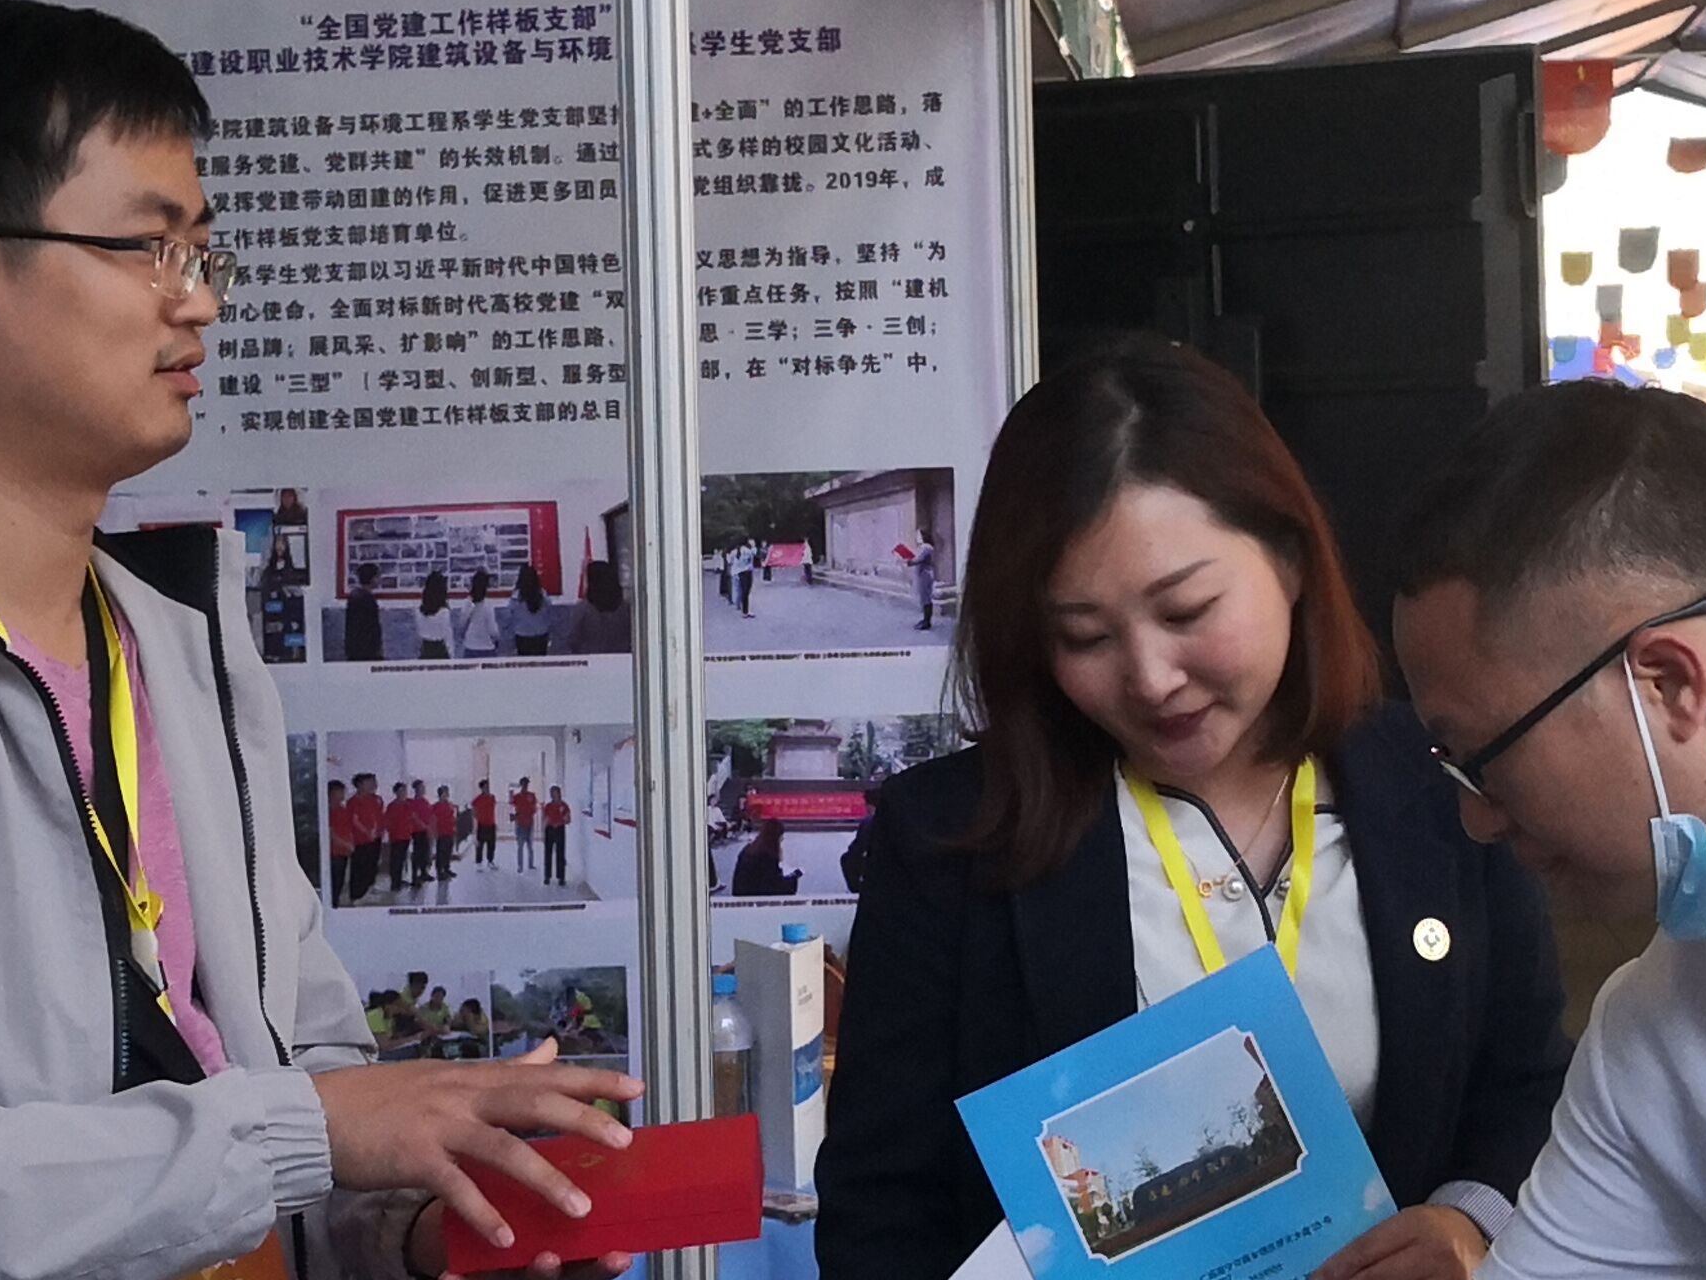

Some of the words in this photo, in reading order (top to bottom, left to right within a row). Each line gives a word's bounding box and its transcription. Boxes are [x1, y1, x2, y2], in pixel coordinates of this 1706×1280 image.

[299, 4, 612, 41] “全国党建工作样板支部”
[177, 37, 612, 76] 建设职业技术学院建筑设备与环境
[690, 26, 842, 57] 学生党支部
